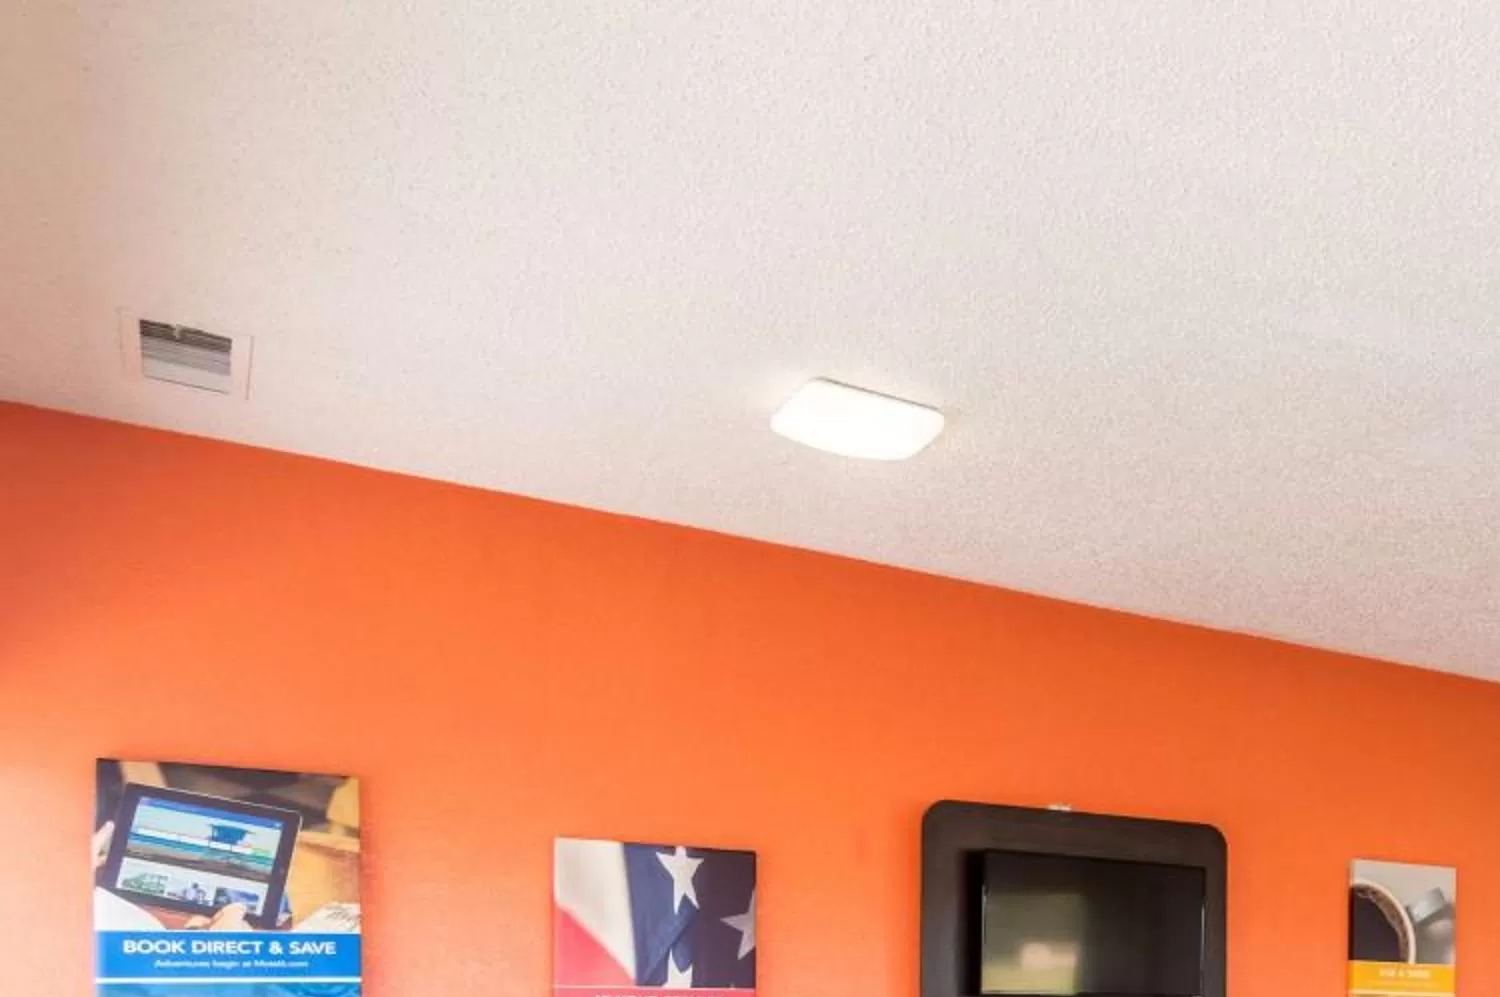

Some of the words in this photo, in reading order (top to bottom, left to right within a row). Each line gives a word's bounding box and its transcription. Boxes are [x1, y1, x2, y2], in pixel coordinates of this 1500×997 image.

[123, 939, 186, 954] BOOK
[191, 940, 263, 954] DIRECT
[268, 941, 282, 955] &
[289, 941, 337, 955] SAVE
